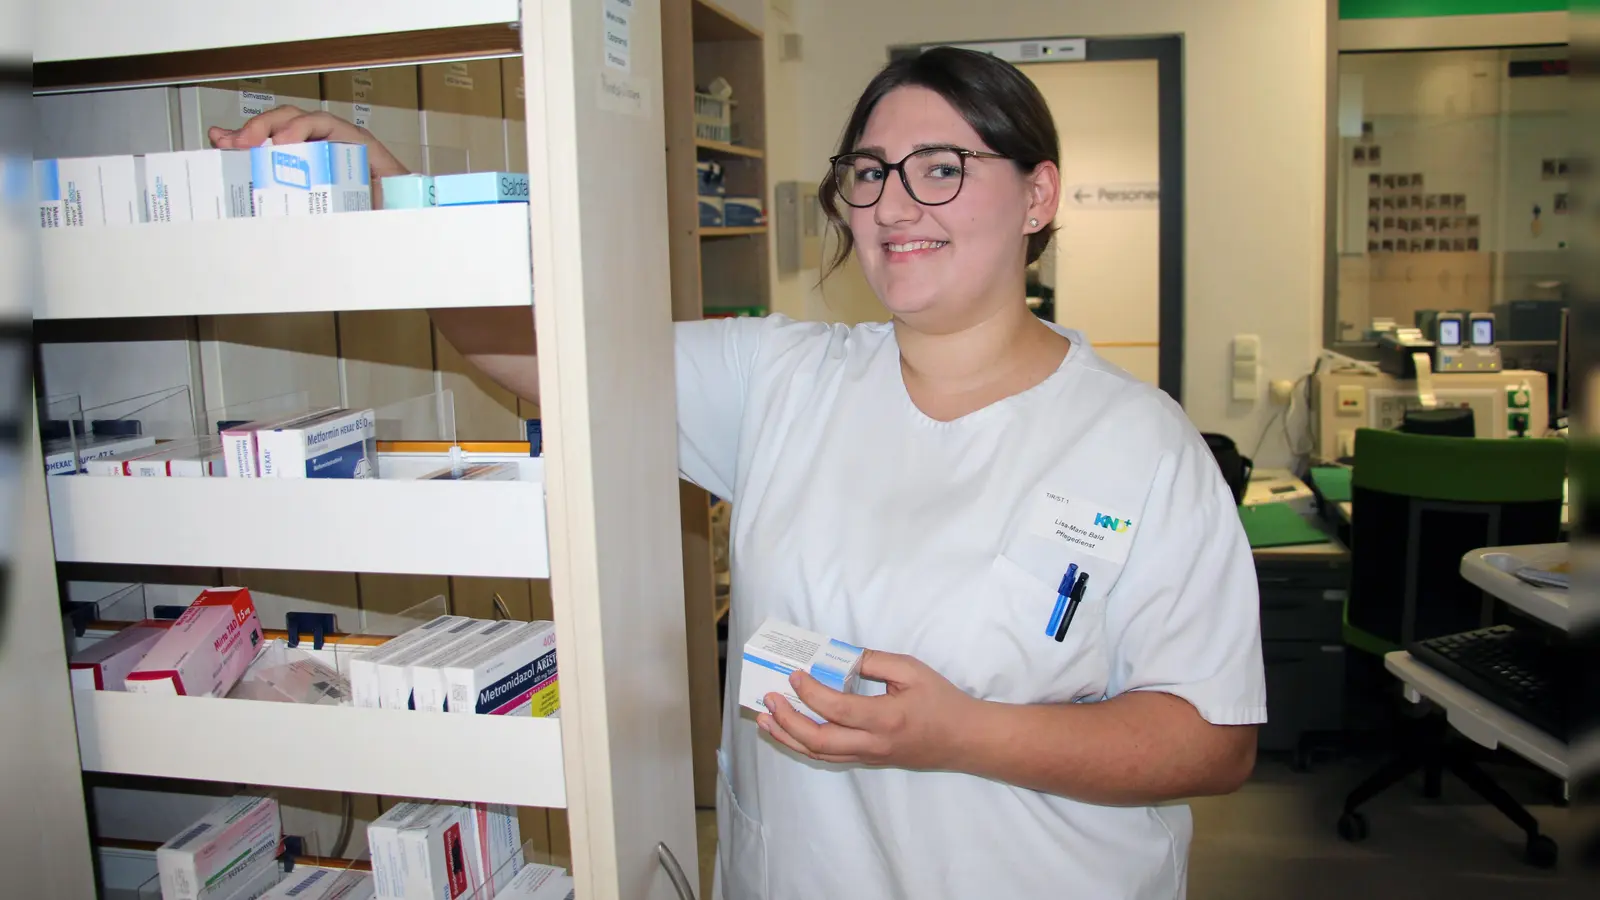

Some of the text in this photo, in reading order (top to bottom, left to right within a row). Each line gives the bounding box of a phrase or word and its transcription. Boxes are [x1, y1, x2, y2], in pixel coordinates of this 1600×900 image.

[242, 90, 274, 101] Simvastatin
[308, 427, 340, 446] Metformin
[1055, 518, 1088, 536] Lisa-Marie
[1056, 529, 1096, 549] Pflegedienst
[226, 619, 238, 634] TAD
[237, 609, 245, 622] 15
[480, 663, 535, 705] Metronidazol
